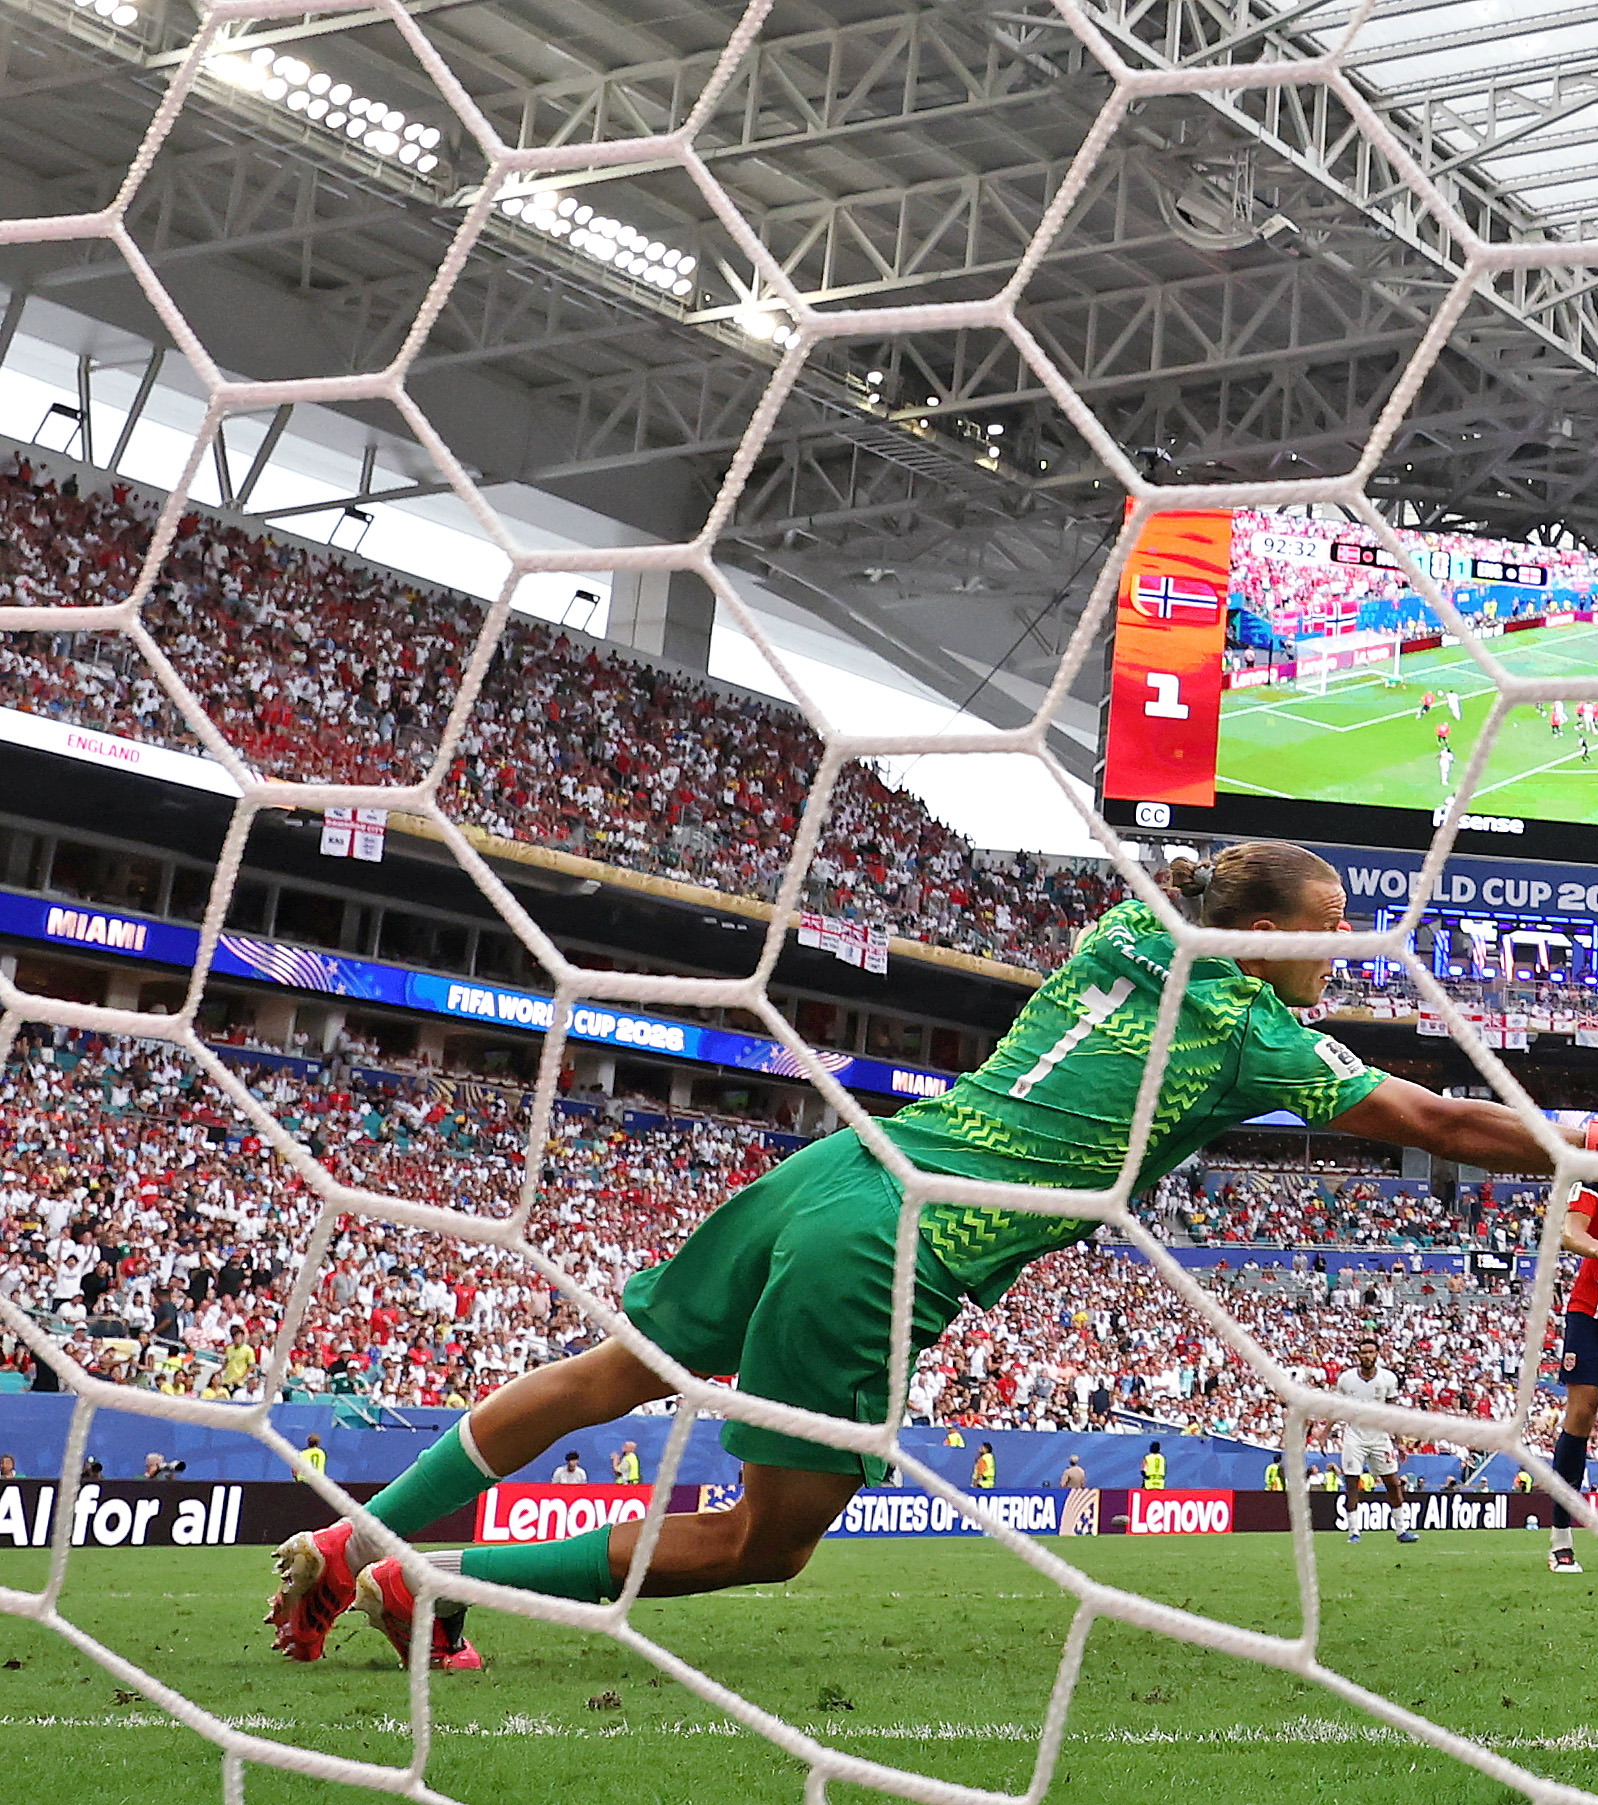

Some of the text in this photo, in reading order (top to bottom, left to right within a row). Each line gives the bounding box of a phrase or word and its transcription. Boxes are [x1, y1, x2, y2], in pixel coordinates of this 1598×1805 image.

[1264, 537, 1317, 558] 92:32
[1144, 672, 1190, 720] 1
[67, 733, 140, 764] ENGLAND
[1140, 808, 1165, 823] CC
[1433, 808, 1525, 834] Hsense
[1482, 877, 1552, 908] CUP
[47, 907, 147, 951] MIAMI
[448, 985, 495, 1017] FIFA
[574, 1010, 616, 1038] CUP
[616, 1018, 685, 1052] 2026
[1008, 976, 1136, 1098] 1
[892, 1070, 947, 1097] MIAMI
[0, 1484, 243, 1547] AI for all
[845, 1496, 929, 1532] STATES
[1131, 1491, 1230, 1533] Lenovo
[1424, 1495, 1448, 1529] AI
[1451, 1493, 1482, 1529] for
[1483, 1494, 1508, 1529] all
